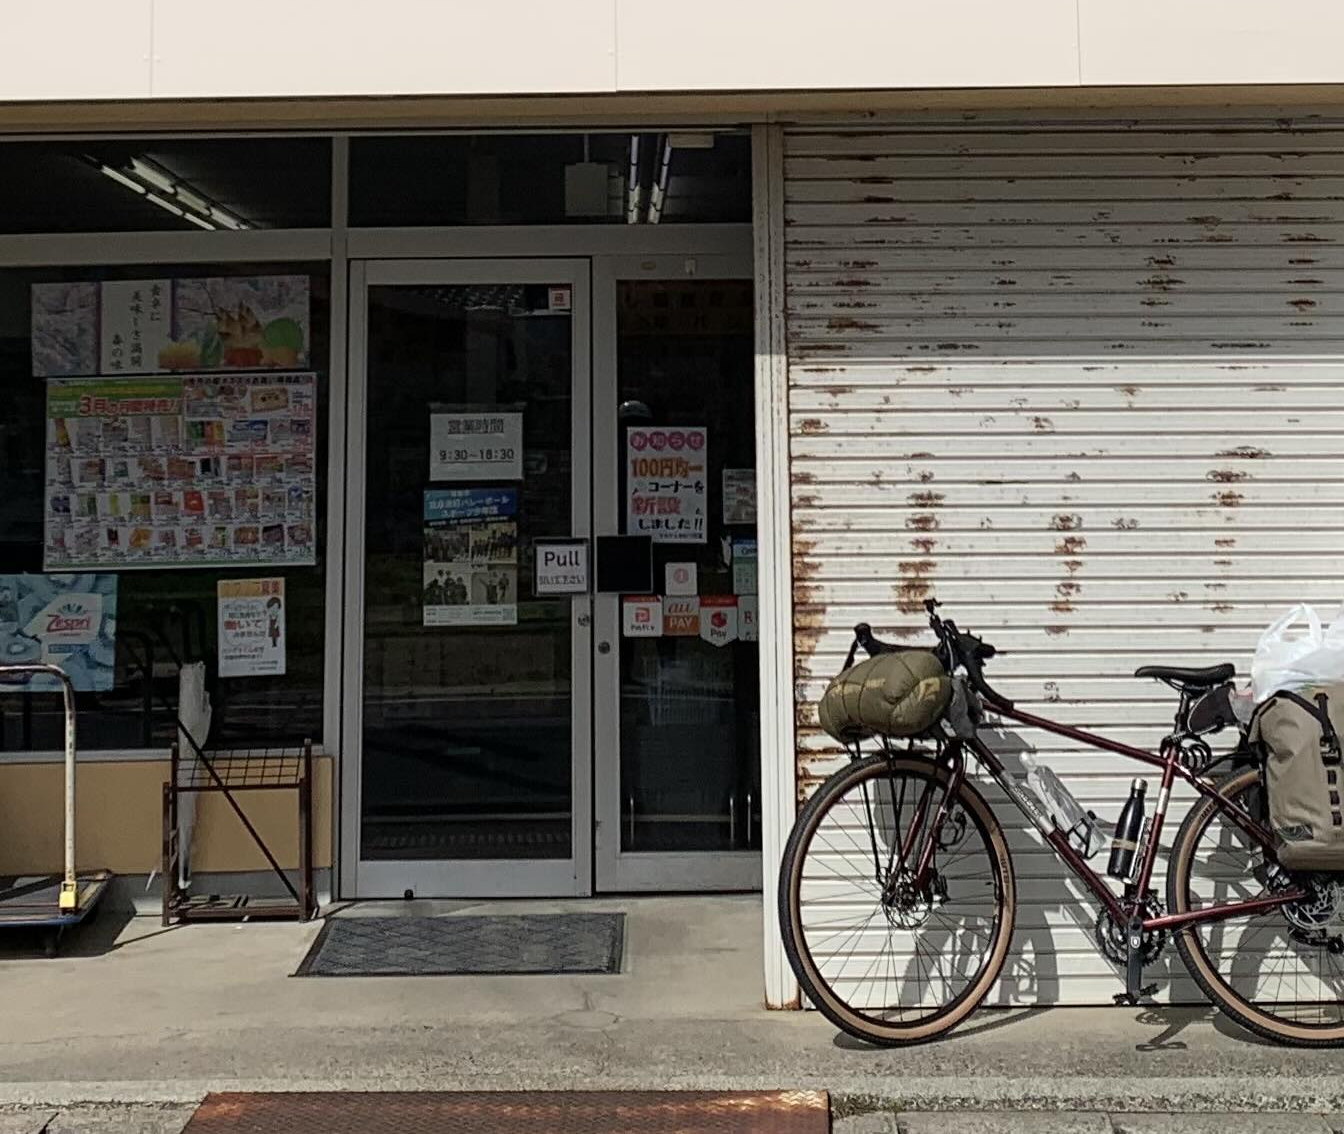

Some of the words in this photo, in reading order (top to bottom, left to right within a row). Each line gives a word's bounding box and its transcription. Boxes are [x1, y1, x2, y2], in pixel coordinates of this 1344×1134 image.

[629, 431, 705, 451] お知らせ
[630, 457, 704, 478] 100円均一
[544, 550, 580, 567] Pull
[669, 617, 693, 629] PAY
